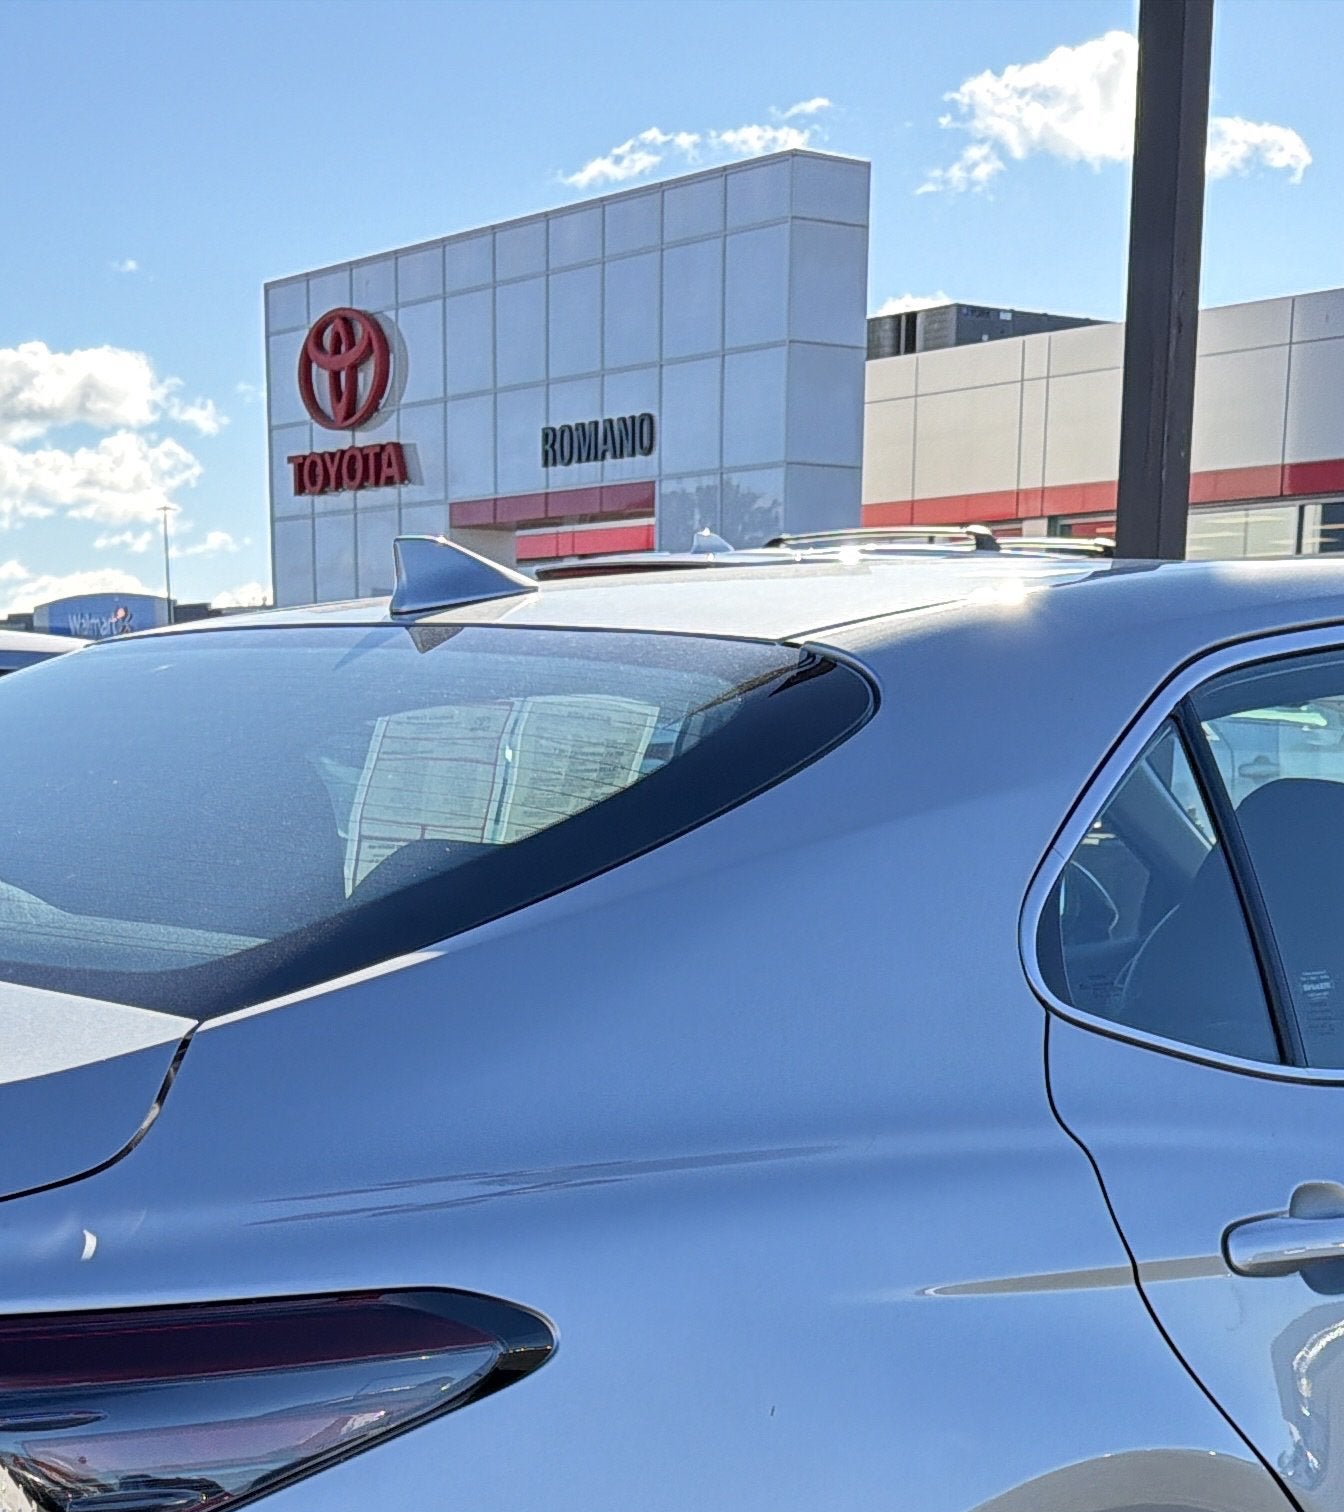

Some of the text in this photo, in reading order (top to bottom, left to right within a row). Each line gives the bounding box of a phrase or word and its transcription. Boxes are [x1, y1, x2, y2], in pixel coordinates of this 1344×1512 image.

[542, 412, 656, 468] ROMANO
[288, 441, 411, 496] TOYOTA
[68, 612, 118, 637] Walmart
